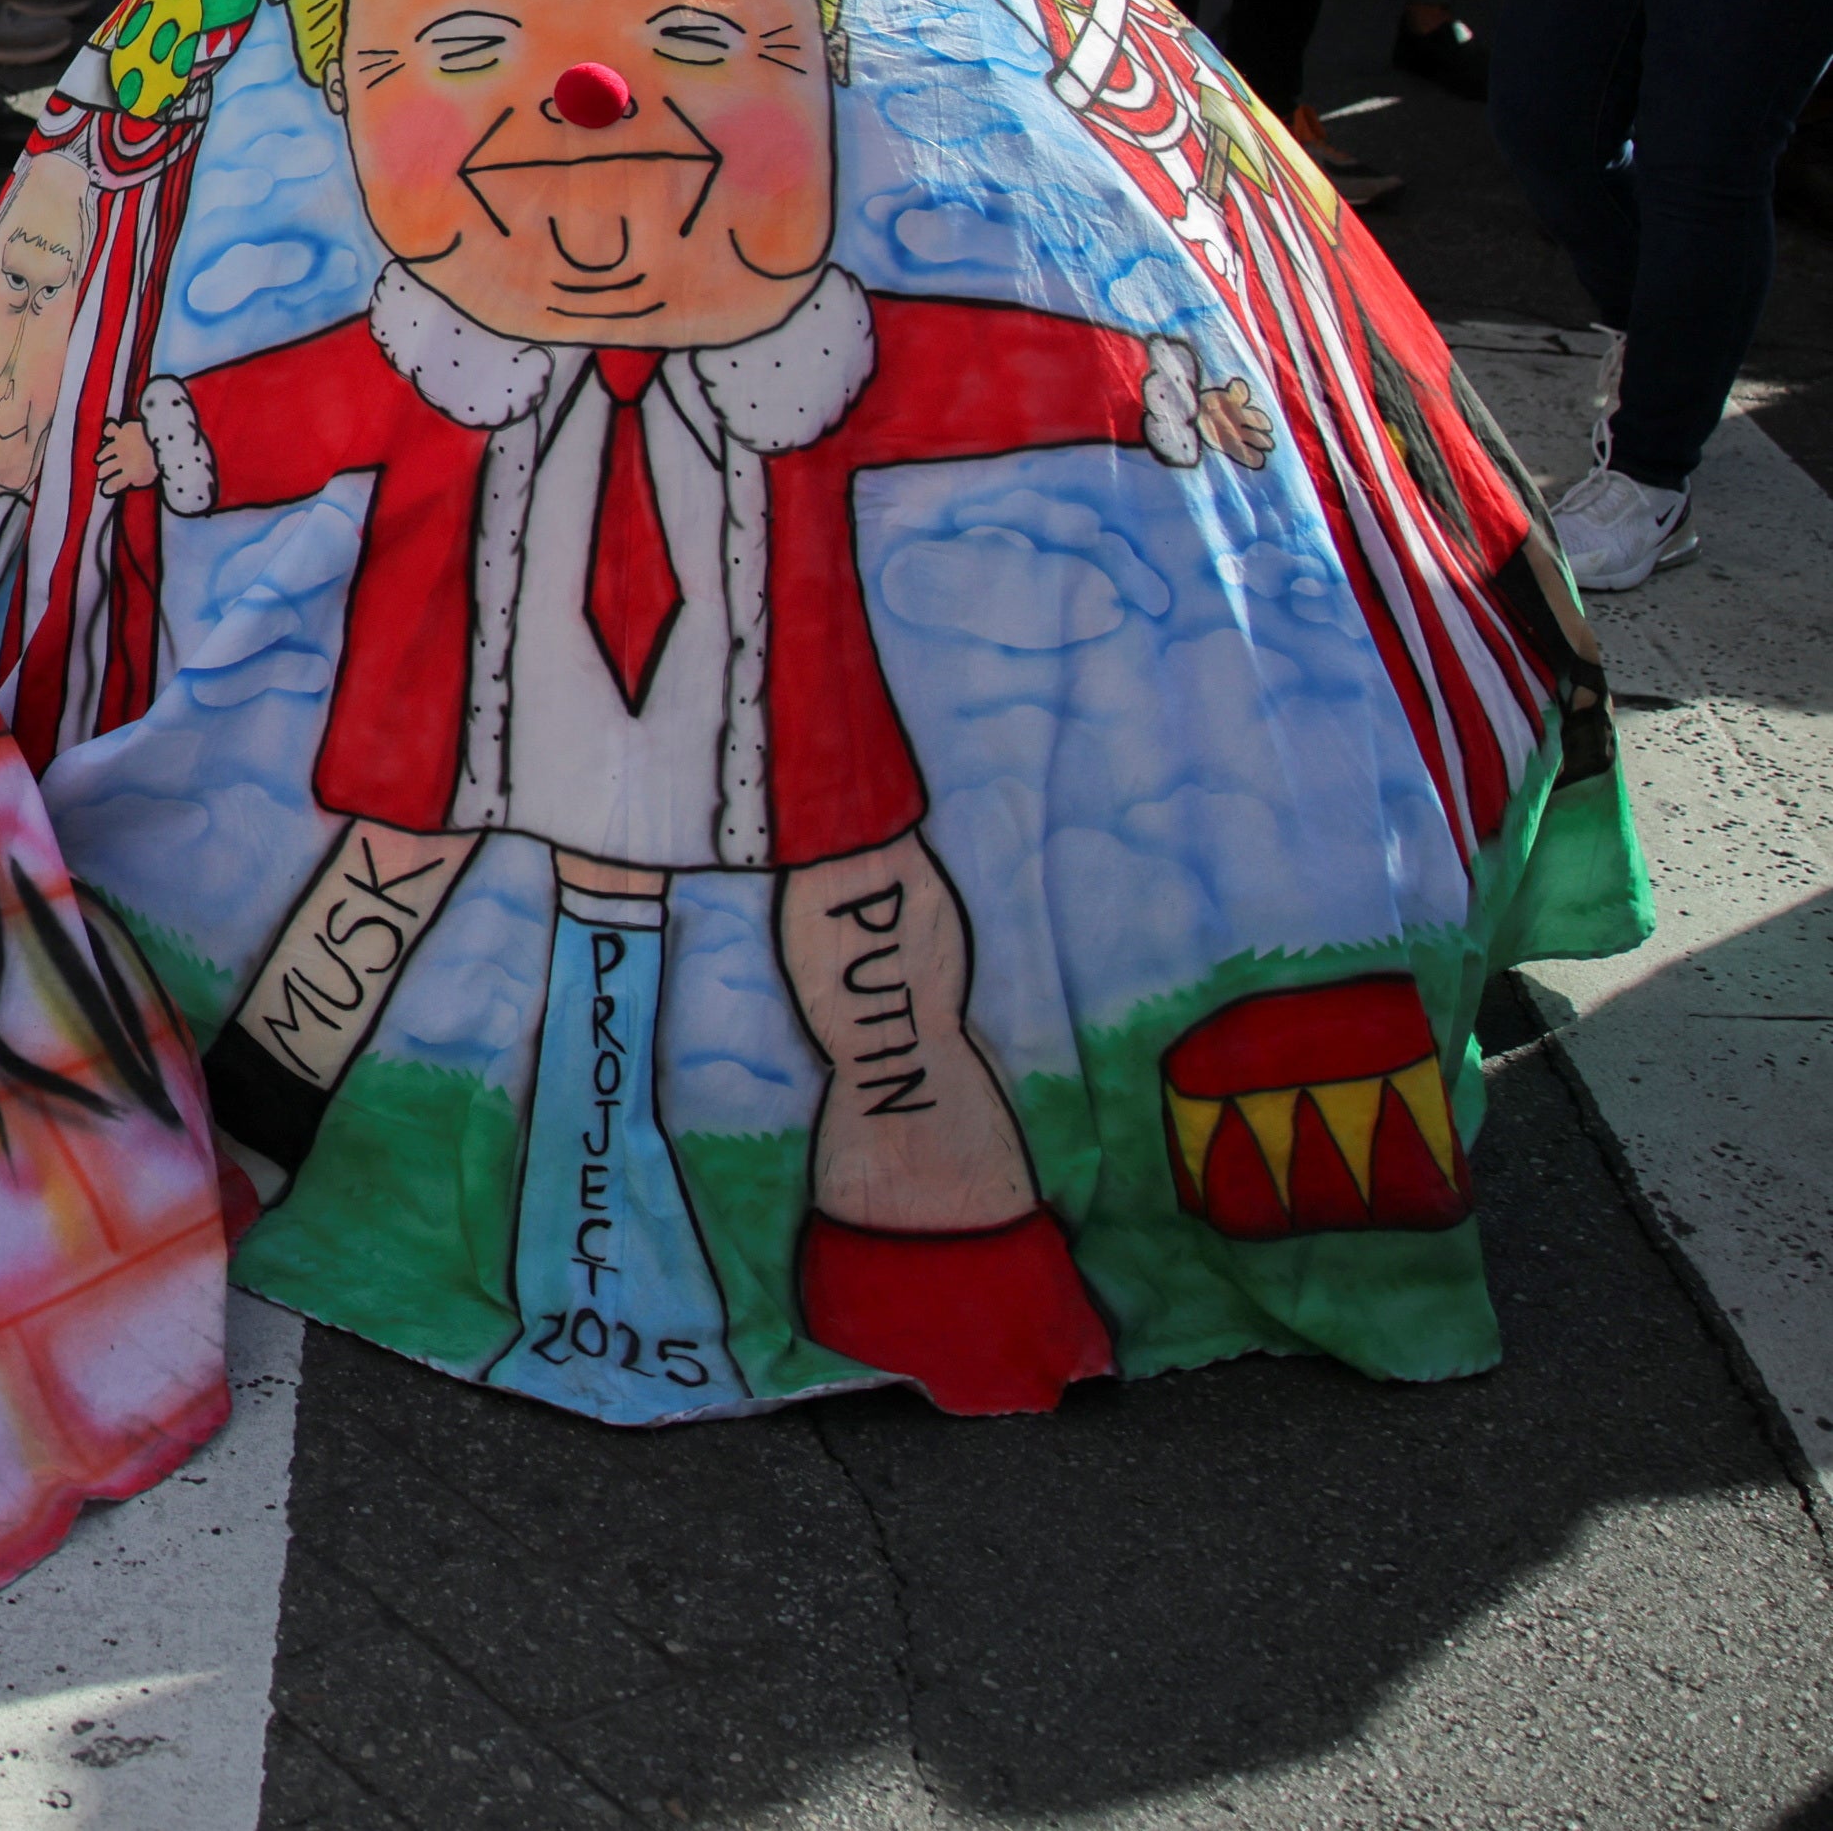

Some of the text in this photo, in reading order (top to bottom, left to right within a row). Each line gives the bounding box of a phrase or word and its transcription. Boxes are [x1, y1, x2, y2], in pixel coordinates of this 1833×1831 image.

[264, 837, 444, 1080] MUSK
[828, 882, 937, 1117] PUTIN
[571, 932, 627, 1296] PROJECT
[531, 1307, 709, 1388] 2025
